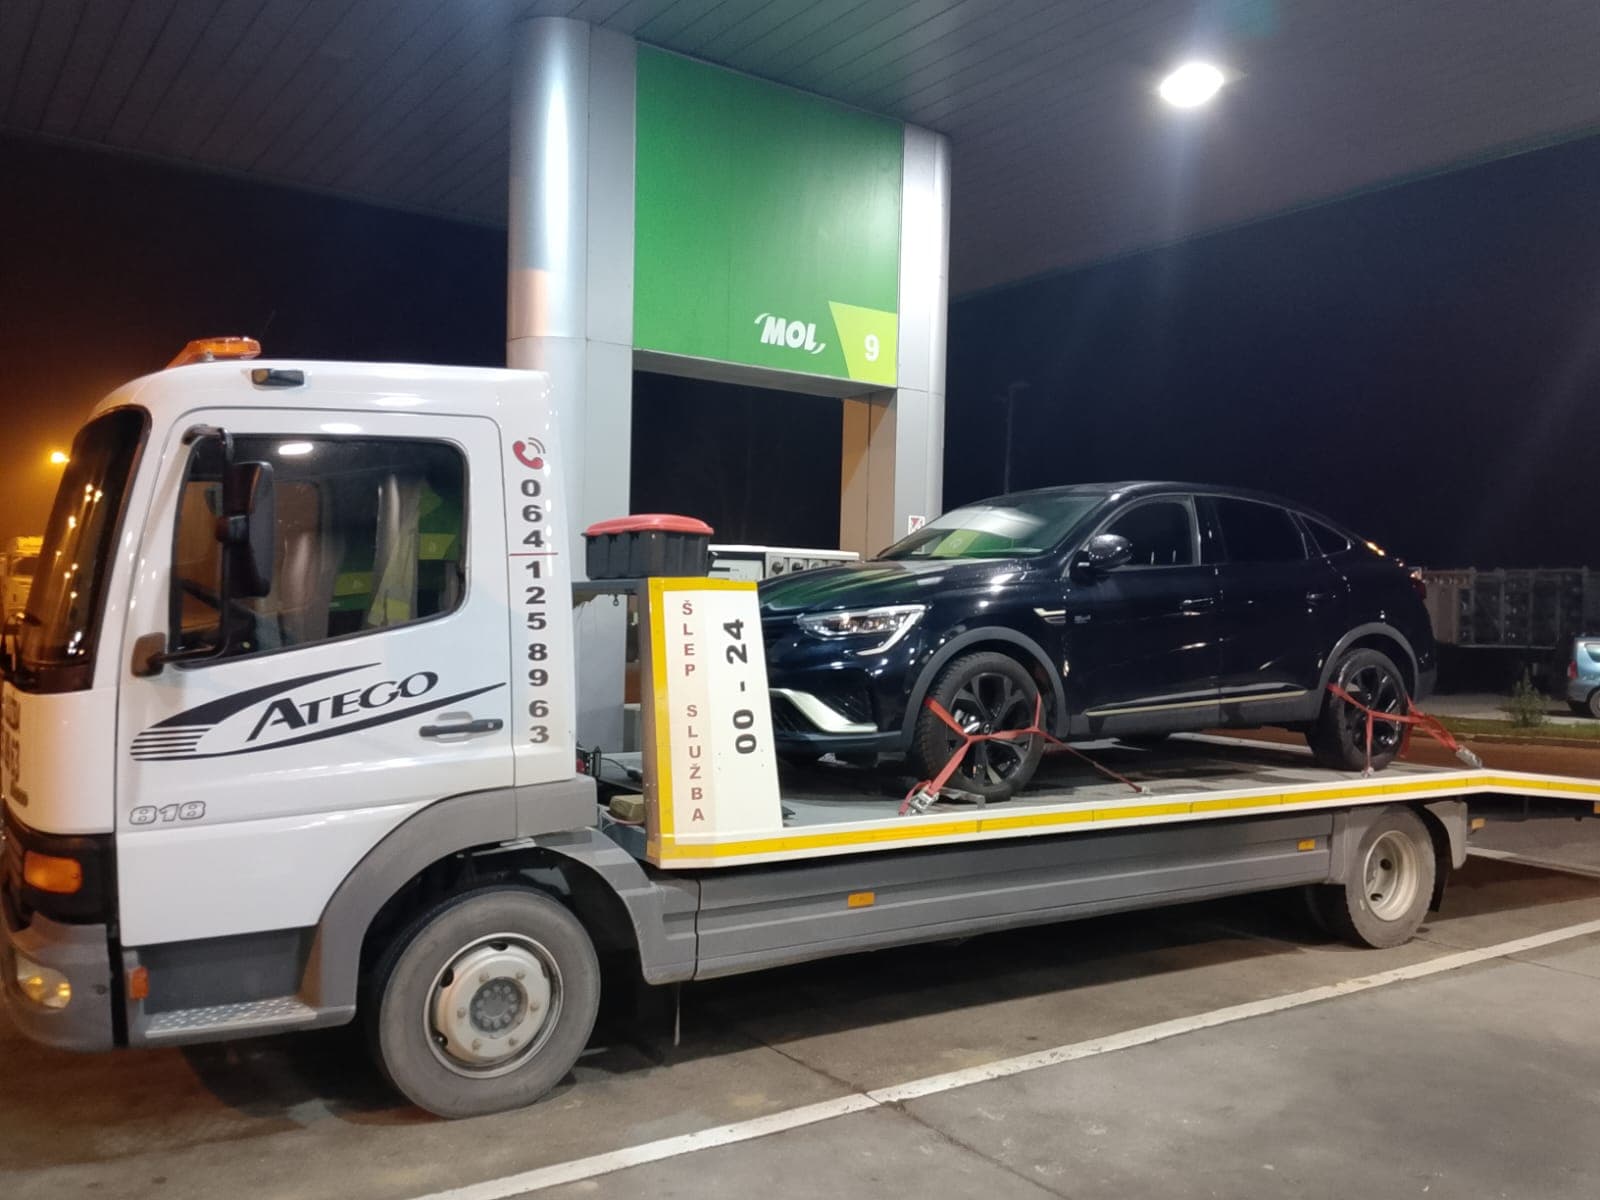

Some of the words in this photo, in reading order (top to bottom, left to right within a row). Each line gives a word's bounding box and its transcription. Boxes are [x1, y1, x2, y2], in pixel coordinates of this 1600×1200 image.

[757, 314, 820, 353] MOL
[864, 334, 880, 362] 9
[520, 478, 545, 548] 064
[682, 599, 696, 676] ŠLEP
[245, 671, 439, 742] ATEGO
[686, 704, 705, 822] SLUŽBA
[128, 801, 206, 825] 818
